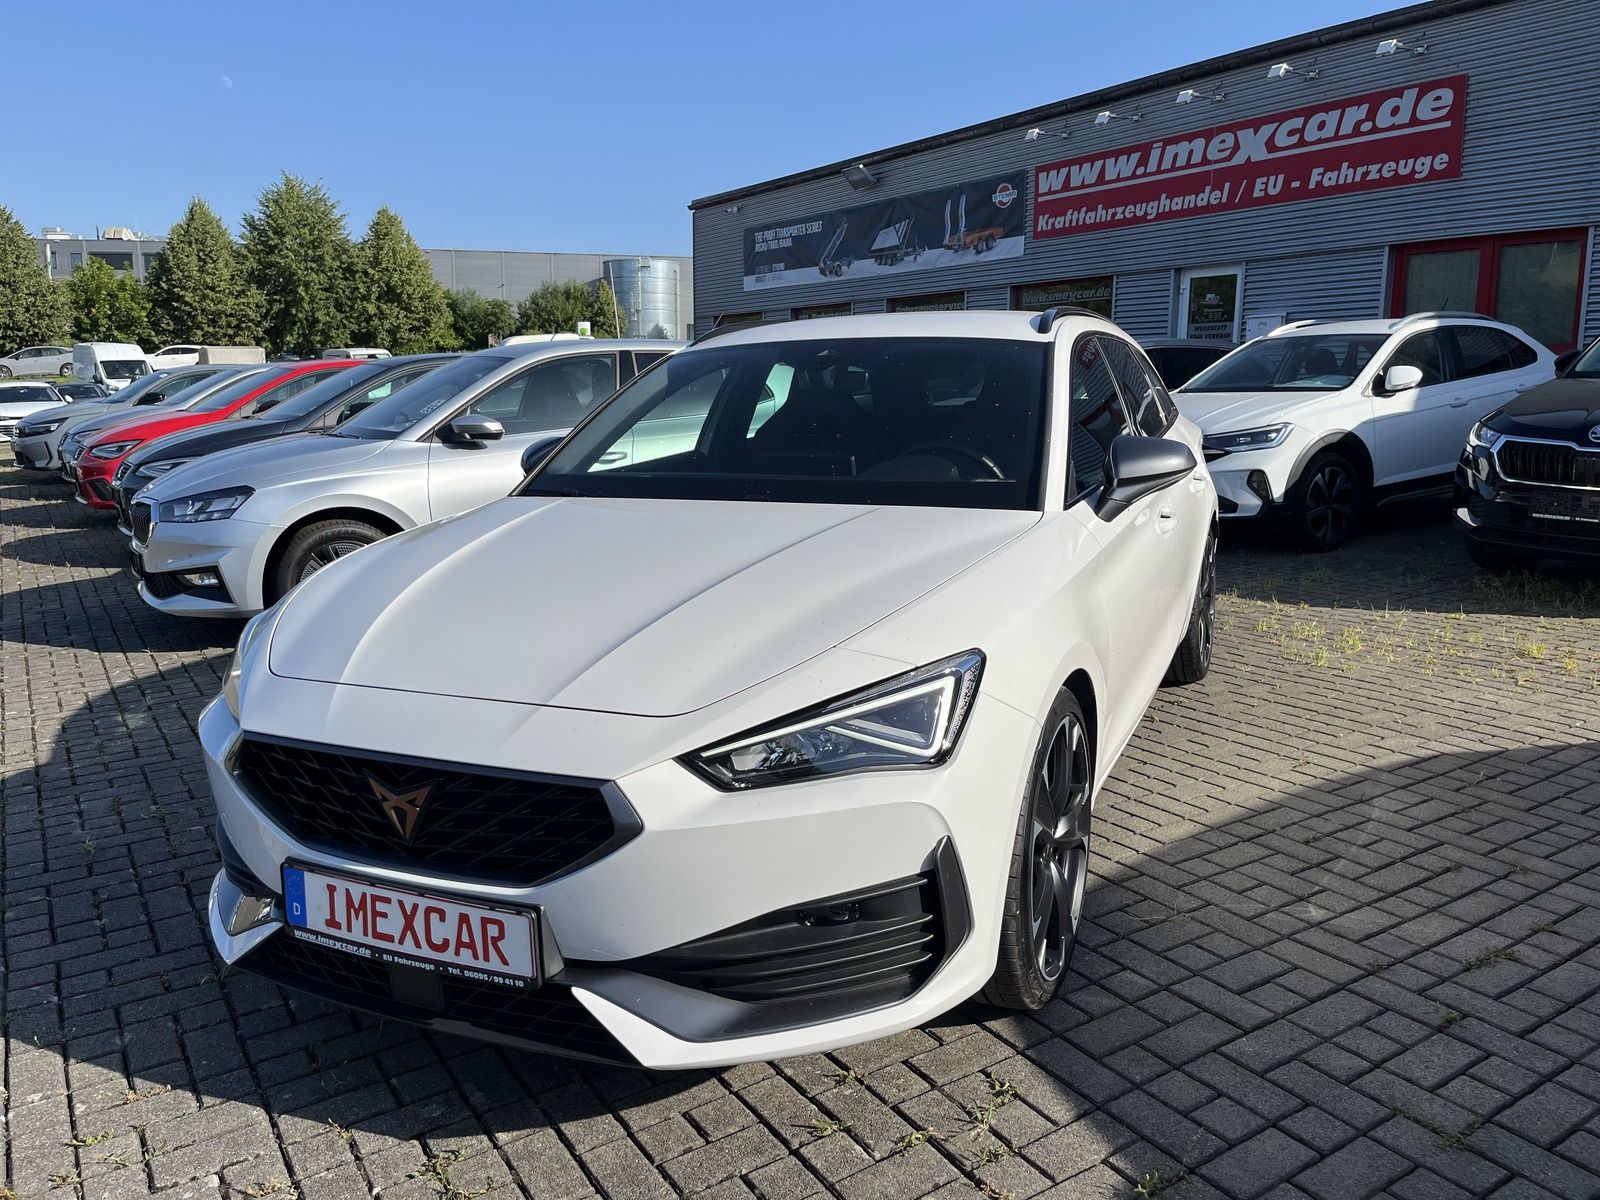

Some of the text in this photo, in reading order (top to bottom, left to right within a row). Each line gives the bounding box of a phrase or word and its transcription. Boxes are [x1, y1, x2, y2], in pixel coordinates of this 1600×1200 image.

[1038, 87, 1454, 194] www.imexcar.de
[754, 231, 763, 243] THE
[806, 220, 823, 234] SERIES
[1037, 182, 1229, 232] Kraftfahrzeughandel
[1252, 174, 1283, 198] EU
[1308, 152, 1450, 190] Fahrzeuge
[293, 883, 510, 966] D IMEXCAR
[294, 929, 371, 957] www.imexcar.de
[382, 953, 392, 961] EU
[394, 956, 435, 970] Fahrzeuge
[447, 966, 463, 976] Tel.
